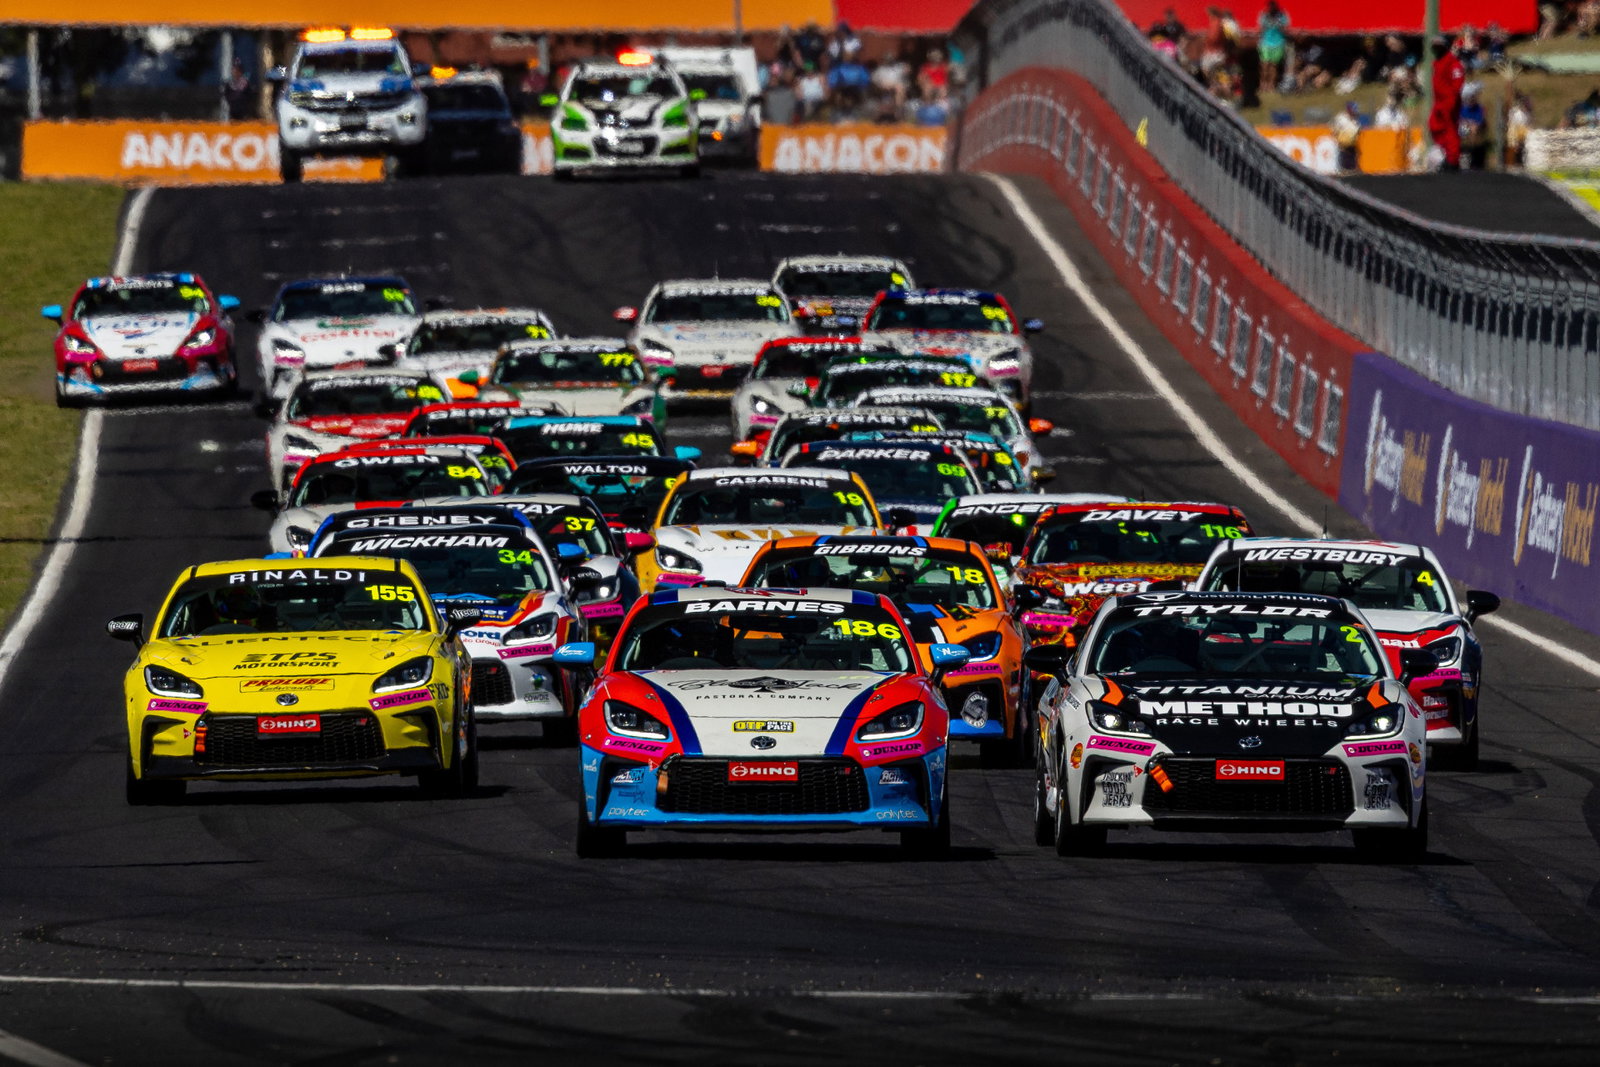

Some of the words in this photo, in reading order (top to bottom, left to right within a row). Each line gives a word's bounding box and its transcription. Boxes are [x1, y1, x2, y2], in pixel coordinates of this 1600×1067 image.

[542, 423, 605, 434] HUME
[621, 432, 654, 447] 45
[334, 455, 441, 468] OWEN
[816, 449, 932, 461] PARKER
[446, 465, 482, 480] 84
[563, 464, 648, 475] WALTON
[715, 476, 829, 488] CASABENE
[832, 491, 864, 506] 19
[503, 503, 566, 515] RAY
[347, 515, 497, 529] CHENEY
[1080, 509, 1203, 523] DAVEY
[565, 516, 597, 531] 37
[1200, 524, 1243, 540] 116
[350, 535, 511, 552] WICKHAM
[814, 544, 927, 556] GIBBONS
[498, 549, 534, 566] 34
[1244, 549, 1407, 567] WESTBURY
[229, 569, 366, 585] RINALDI
[946, 566, 986, 584] 18
[1416, 570, 1435, 587] 4
[364, 584, 415, 602] 155
[684, 600, 845, 614] BARNES
[1134, 604, 1332, 619] TAYLOR
[833, 618, 902, 639] 186
[1339, 625, 1364, 643] 2
[511, 646, 553, 656] DUNLOP
[233, 661, 341, 670] MOTORSPORT
[956, 664, 999, 673] DUNLOP
[243, 678, 332, 687] PROLUBE
[1133, 686, 1356, 697] TITANIUM
[382, 691, 429, 706] DUNLOP
[157, 701, 206, 711] DUNLOP
[1139, 701, 1353, 717] METHOD
[276, 719, 318, 728] HINO
[1156, 718, 1219, 726] RACE
[1235, 718, 1338, 727] WHEELS
[611, 740, 664, 752] DUNLOP
[873, 743, 922, 755] DUNLOP
[1099, 739, 1152, 752] DUNLOP
[1358, 743, 1405, 753] DUNLOP
[749, 767, 796, 775] HINO
[1237, 766, 1281, 775] HINO
